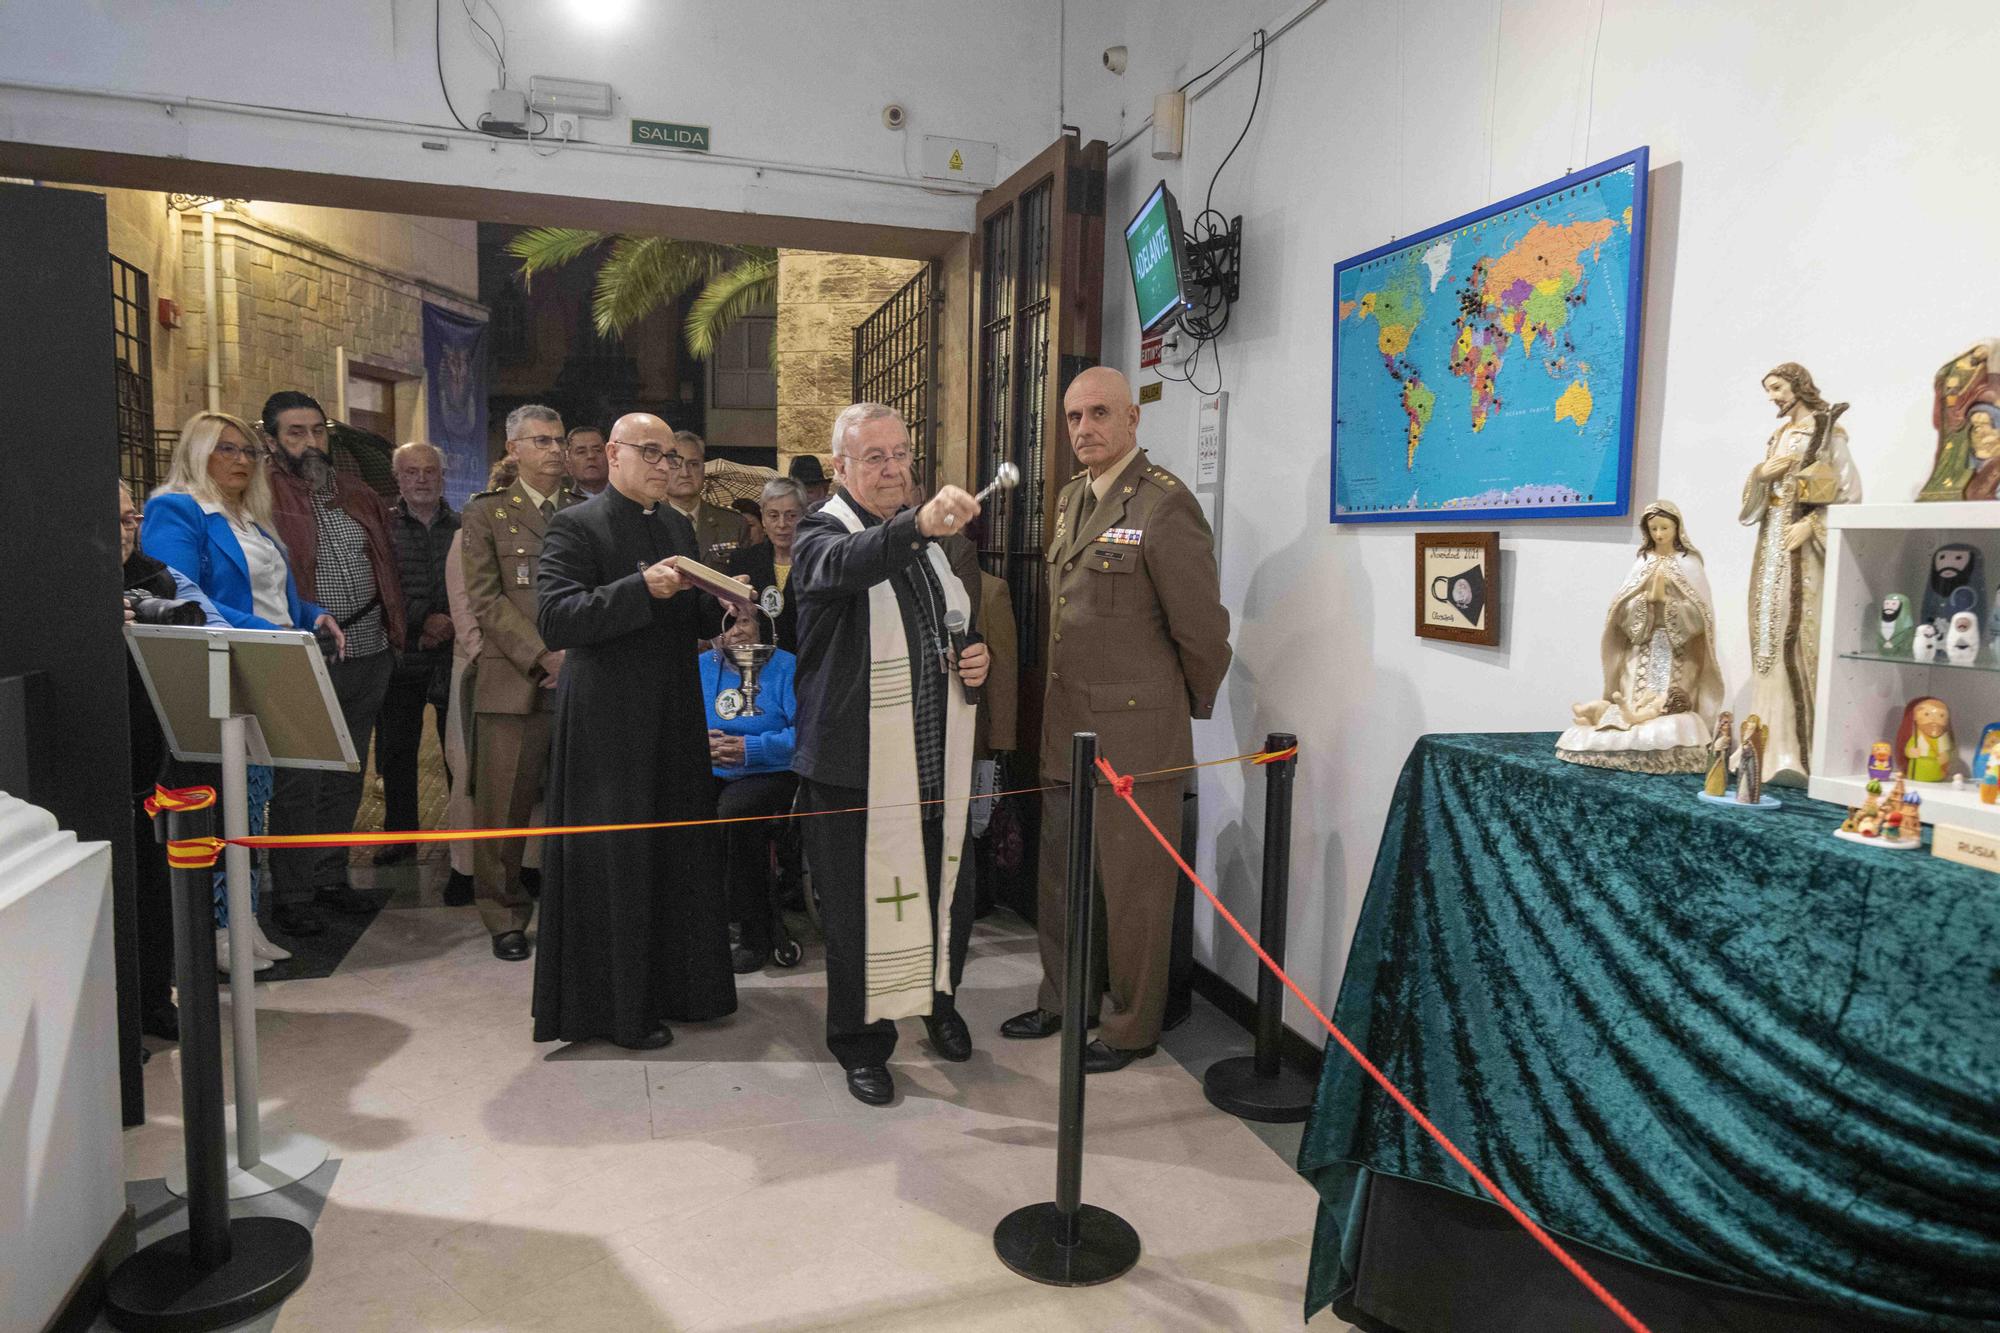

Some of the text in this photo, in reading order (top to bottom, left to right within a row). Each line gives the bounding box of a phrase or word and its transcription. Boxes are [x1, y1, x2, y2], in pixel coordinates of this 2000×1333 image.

[638, 126, 705, 145] SALIDA
[1135, 223, 1169, 283] ADELANTE
[1957, 841, 1998, 861] RUSIA
